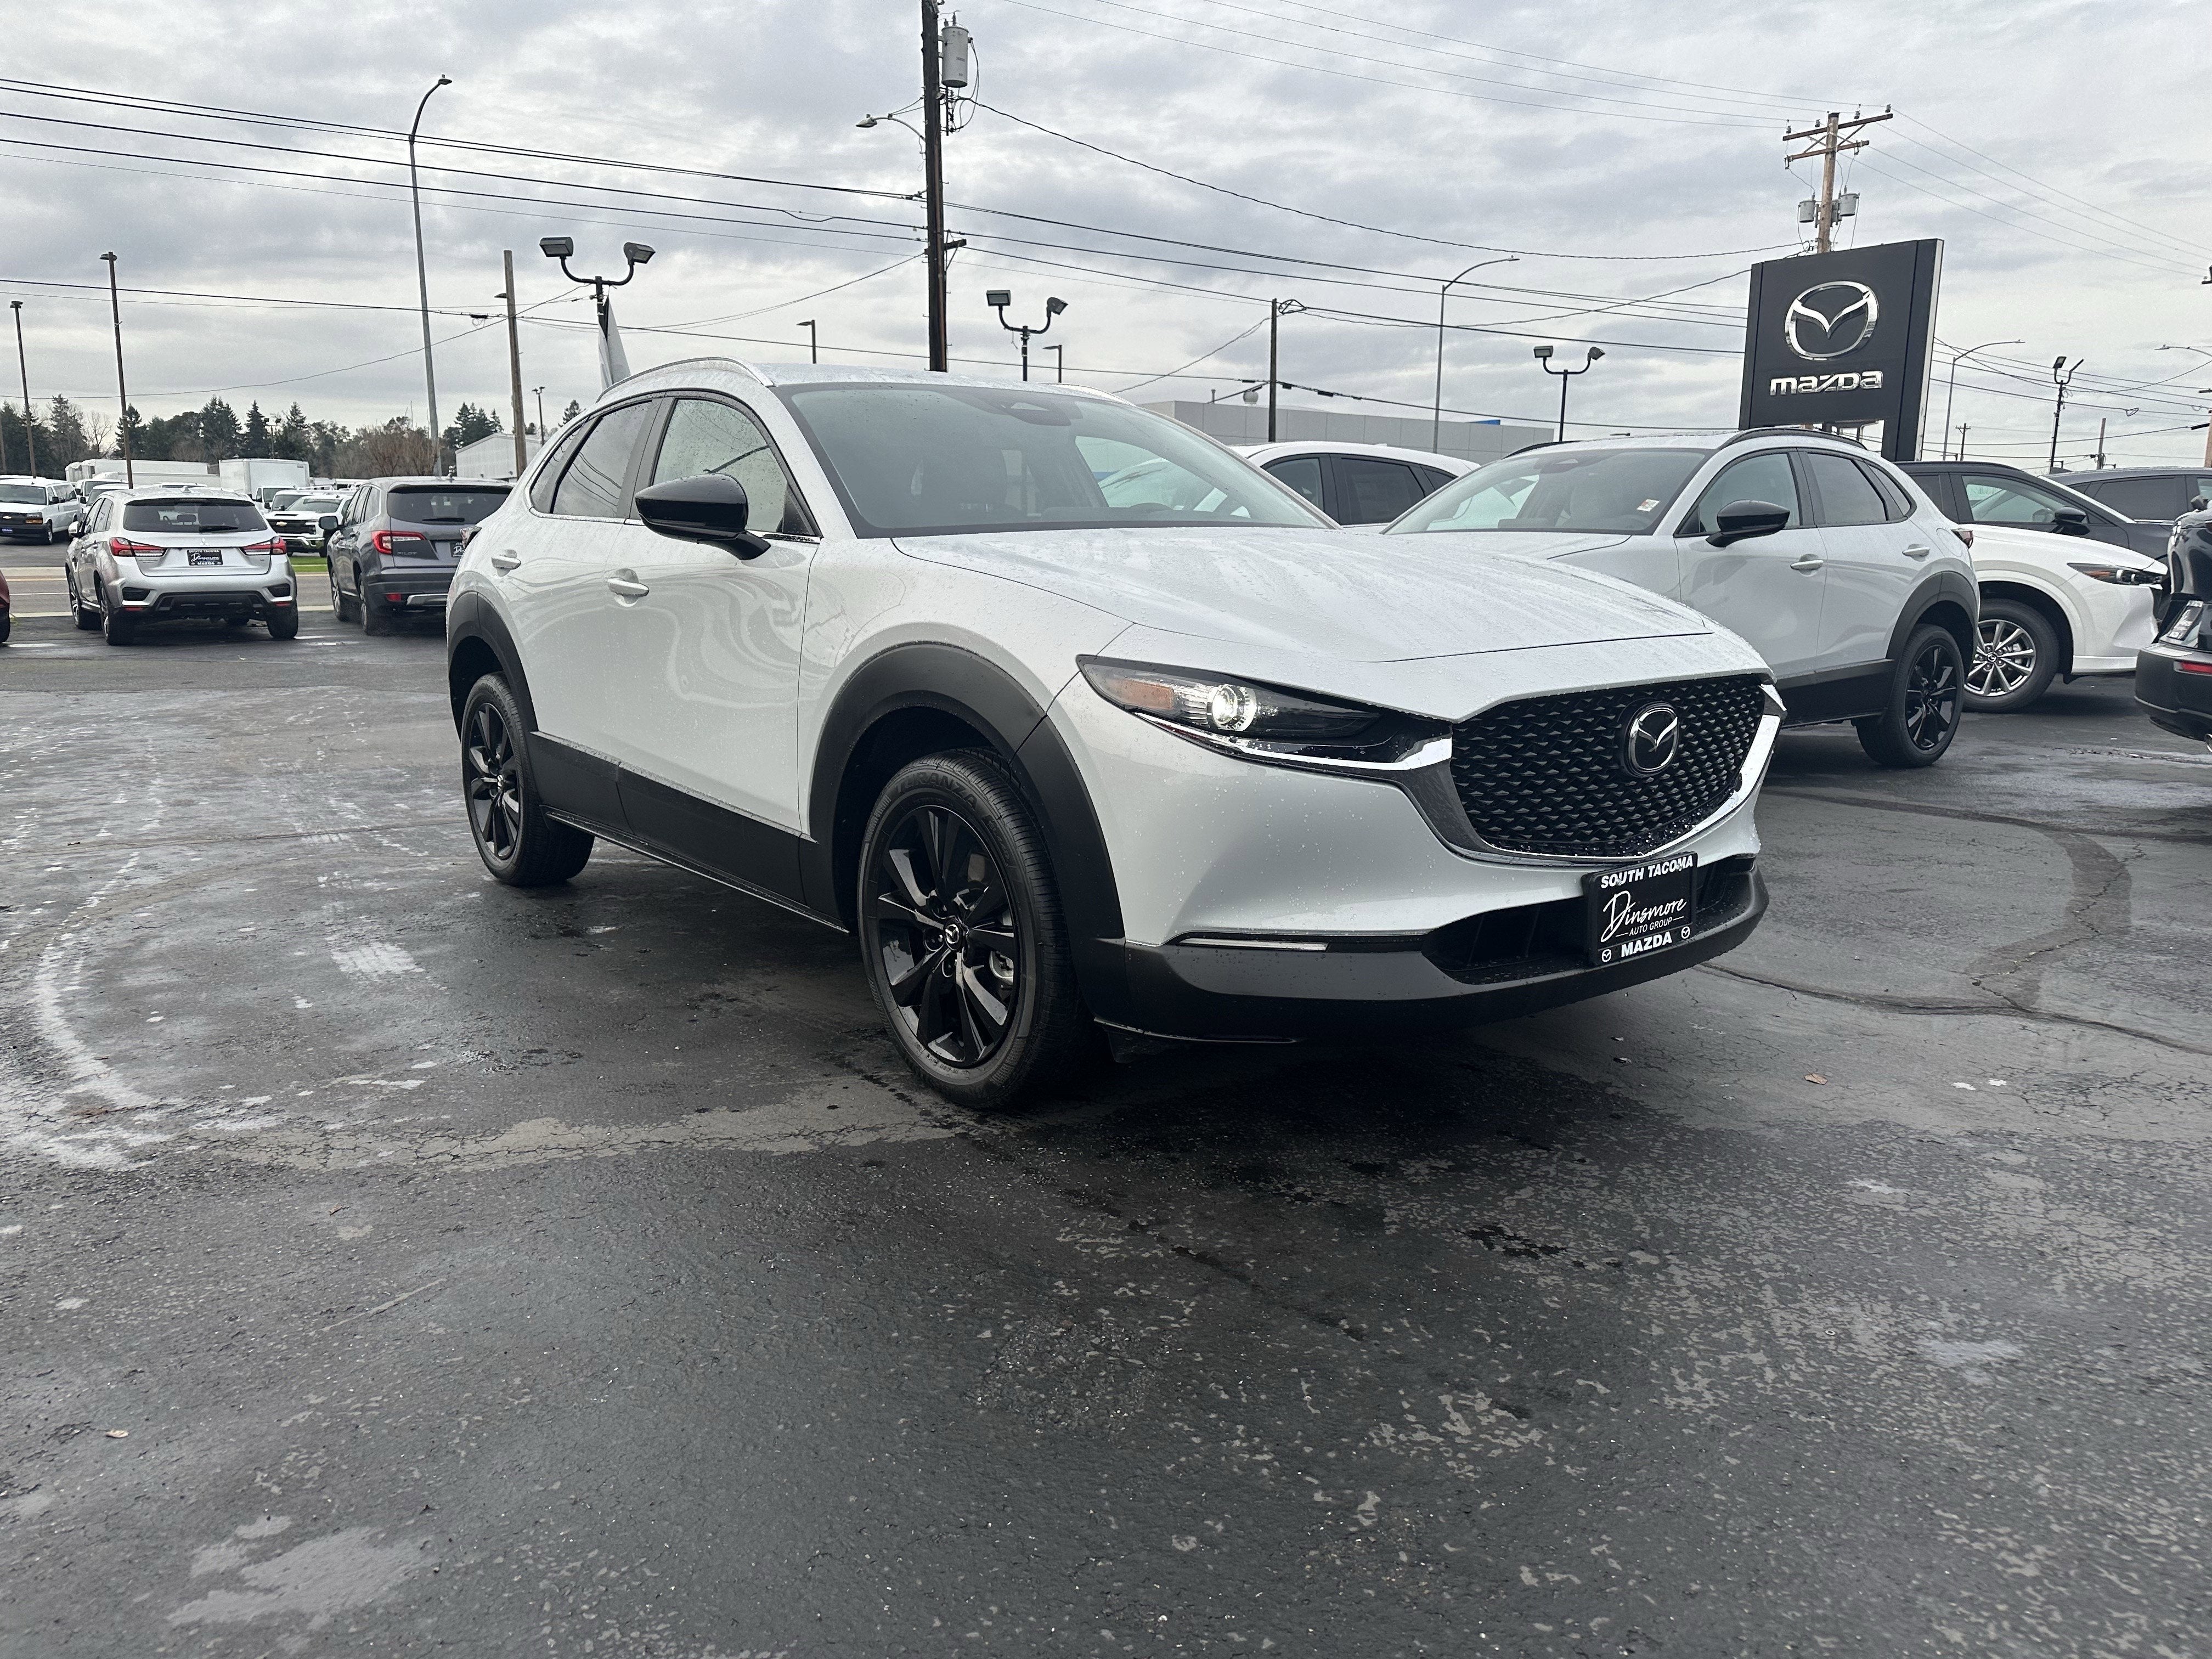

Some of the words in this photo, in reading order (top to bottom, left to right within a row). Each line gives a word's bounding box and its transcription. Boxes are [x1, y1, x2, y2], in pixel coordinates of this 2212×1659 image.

[894, 772, 979, 810] TURANZA
[1600, 867, 1644, 889] SOUTH
[1647, 855, 1694, 878] TACOMA
[1600, 890, 1687, 943] Dinsmore
[1629, 925, 1648, 936] AUTO
[1649, 917, 1672, 931] GROUP
[1621, 931, 1673, 958] MAZDA
